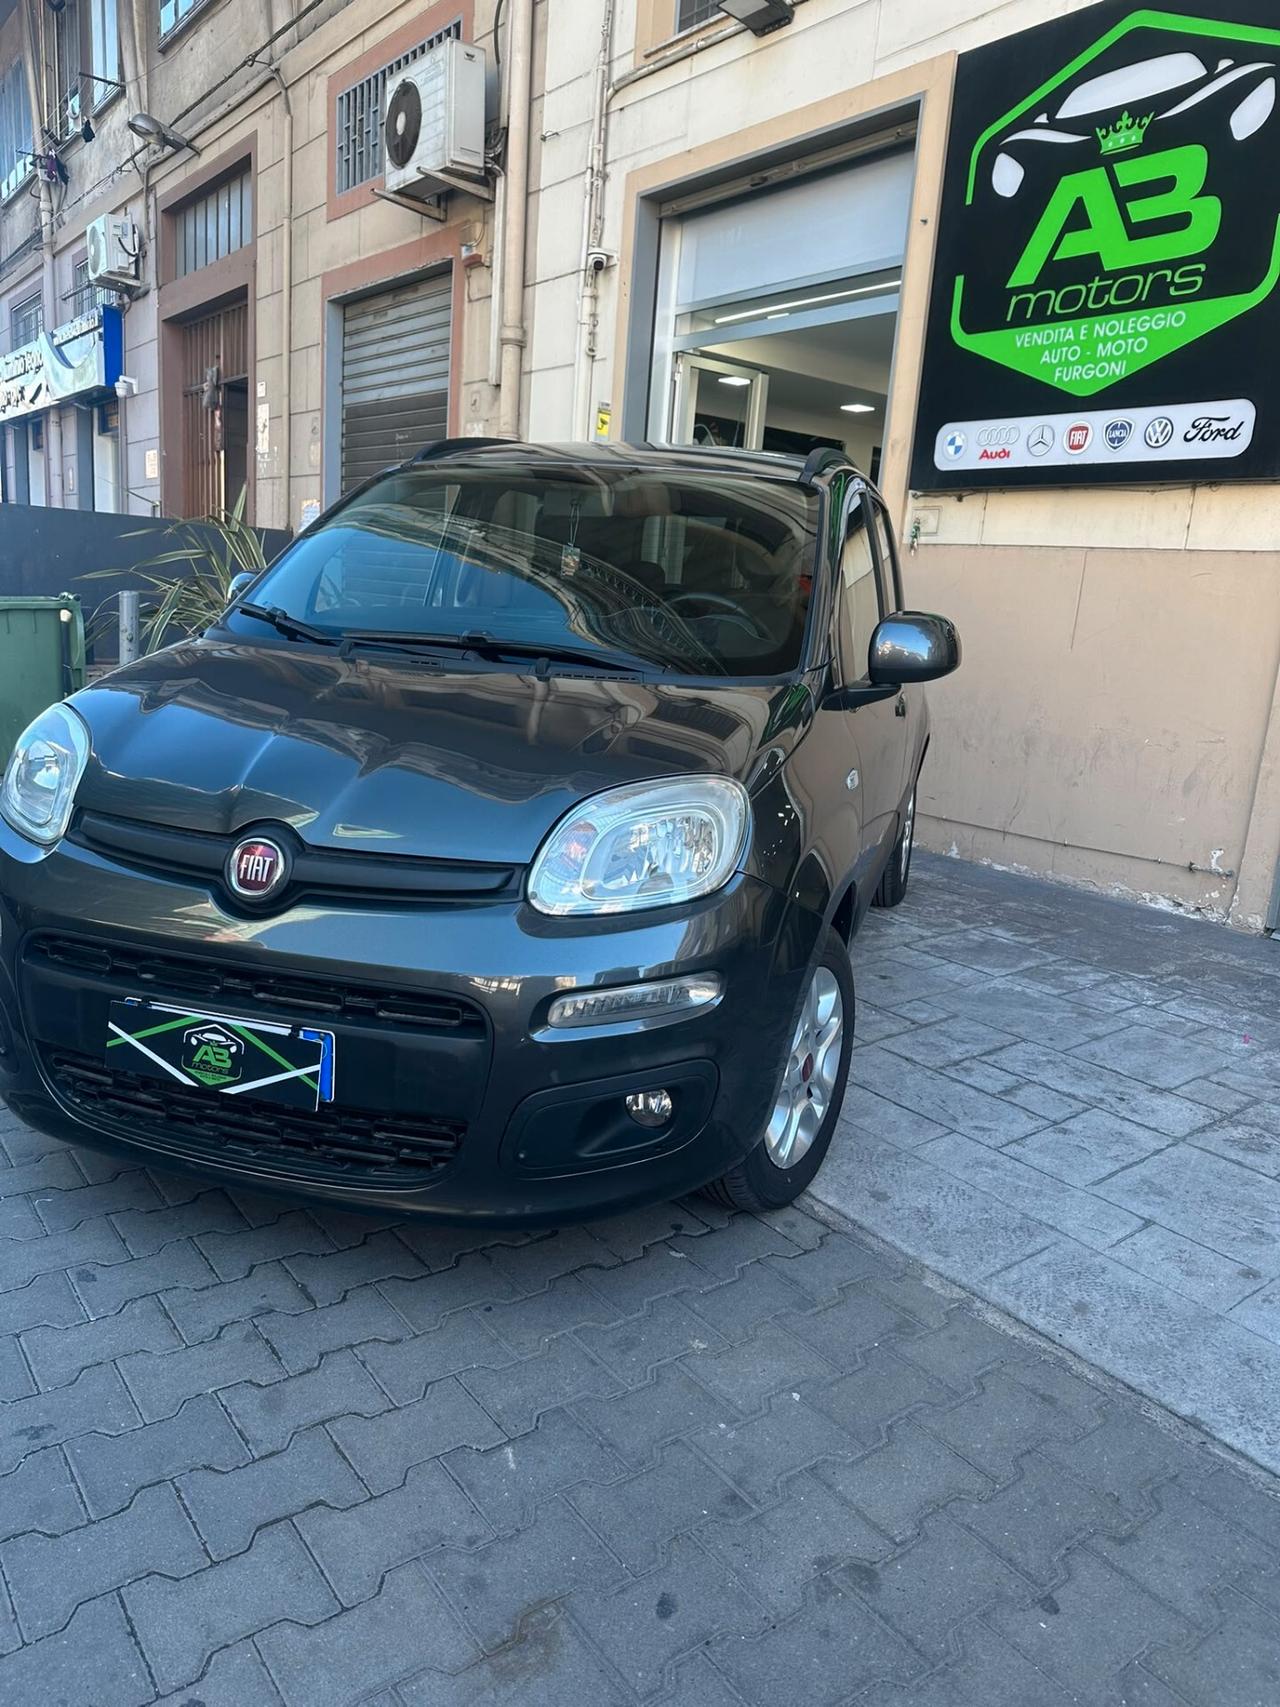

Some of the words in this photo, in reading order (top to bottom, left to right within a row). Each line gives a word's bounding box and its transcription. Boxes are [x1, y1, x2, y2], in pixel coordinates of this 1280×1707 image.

[1005, 143, 1223, 289] AB
[1006, 262, 1207, 322] motors
[1015, 327, 1075, 348] VENDITA
[1079, 324, 1089, 341] E
[1093, 310, 1187, 338] NOLEGGIO
[1040, 345, 1081, 365] AUTO
[1096, 337, 1149, 359] MOTO
[1053, 360, 1127, 383] FURGONI
[1069, 430, 1088, 446] FIAT
[1183, 416, 1245, 443] Ford
[979, 447, 1011, 460] Audi
[239, 854, 274, 882] FIAT
[192, 1044, 233, 1069] AB
